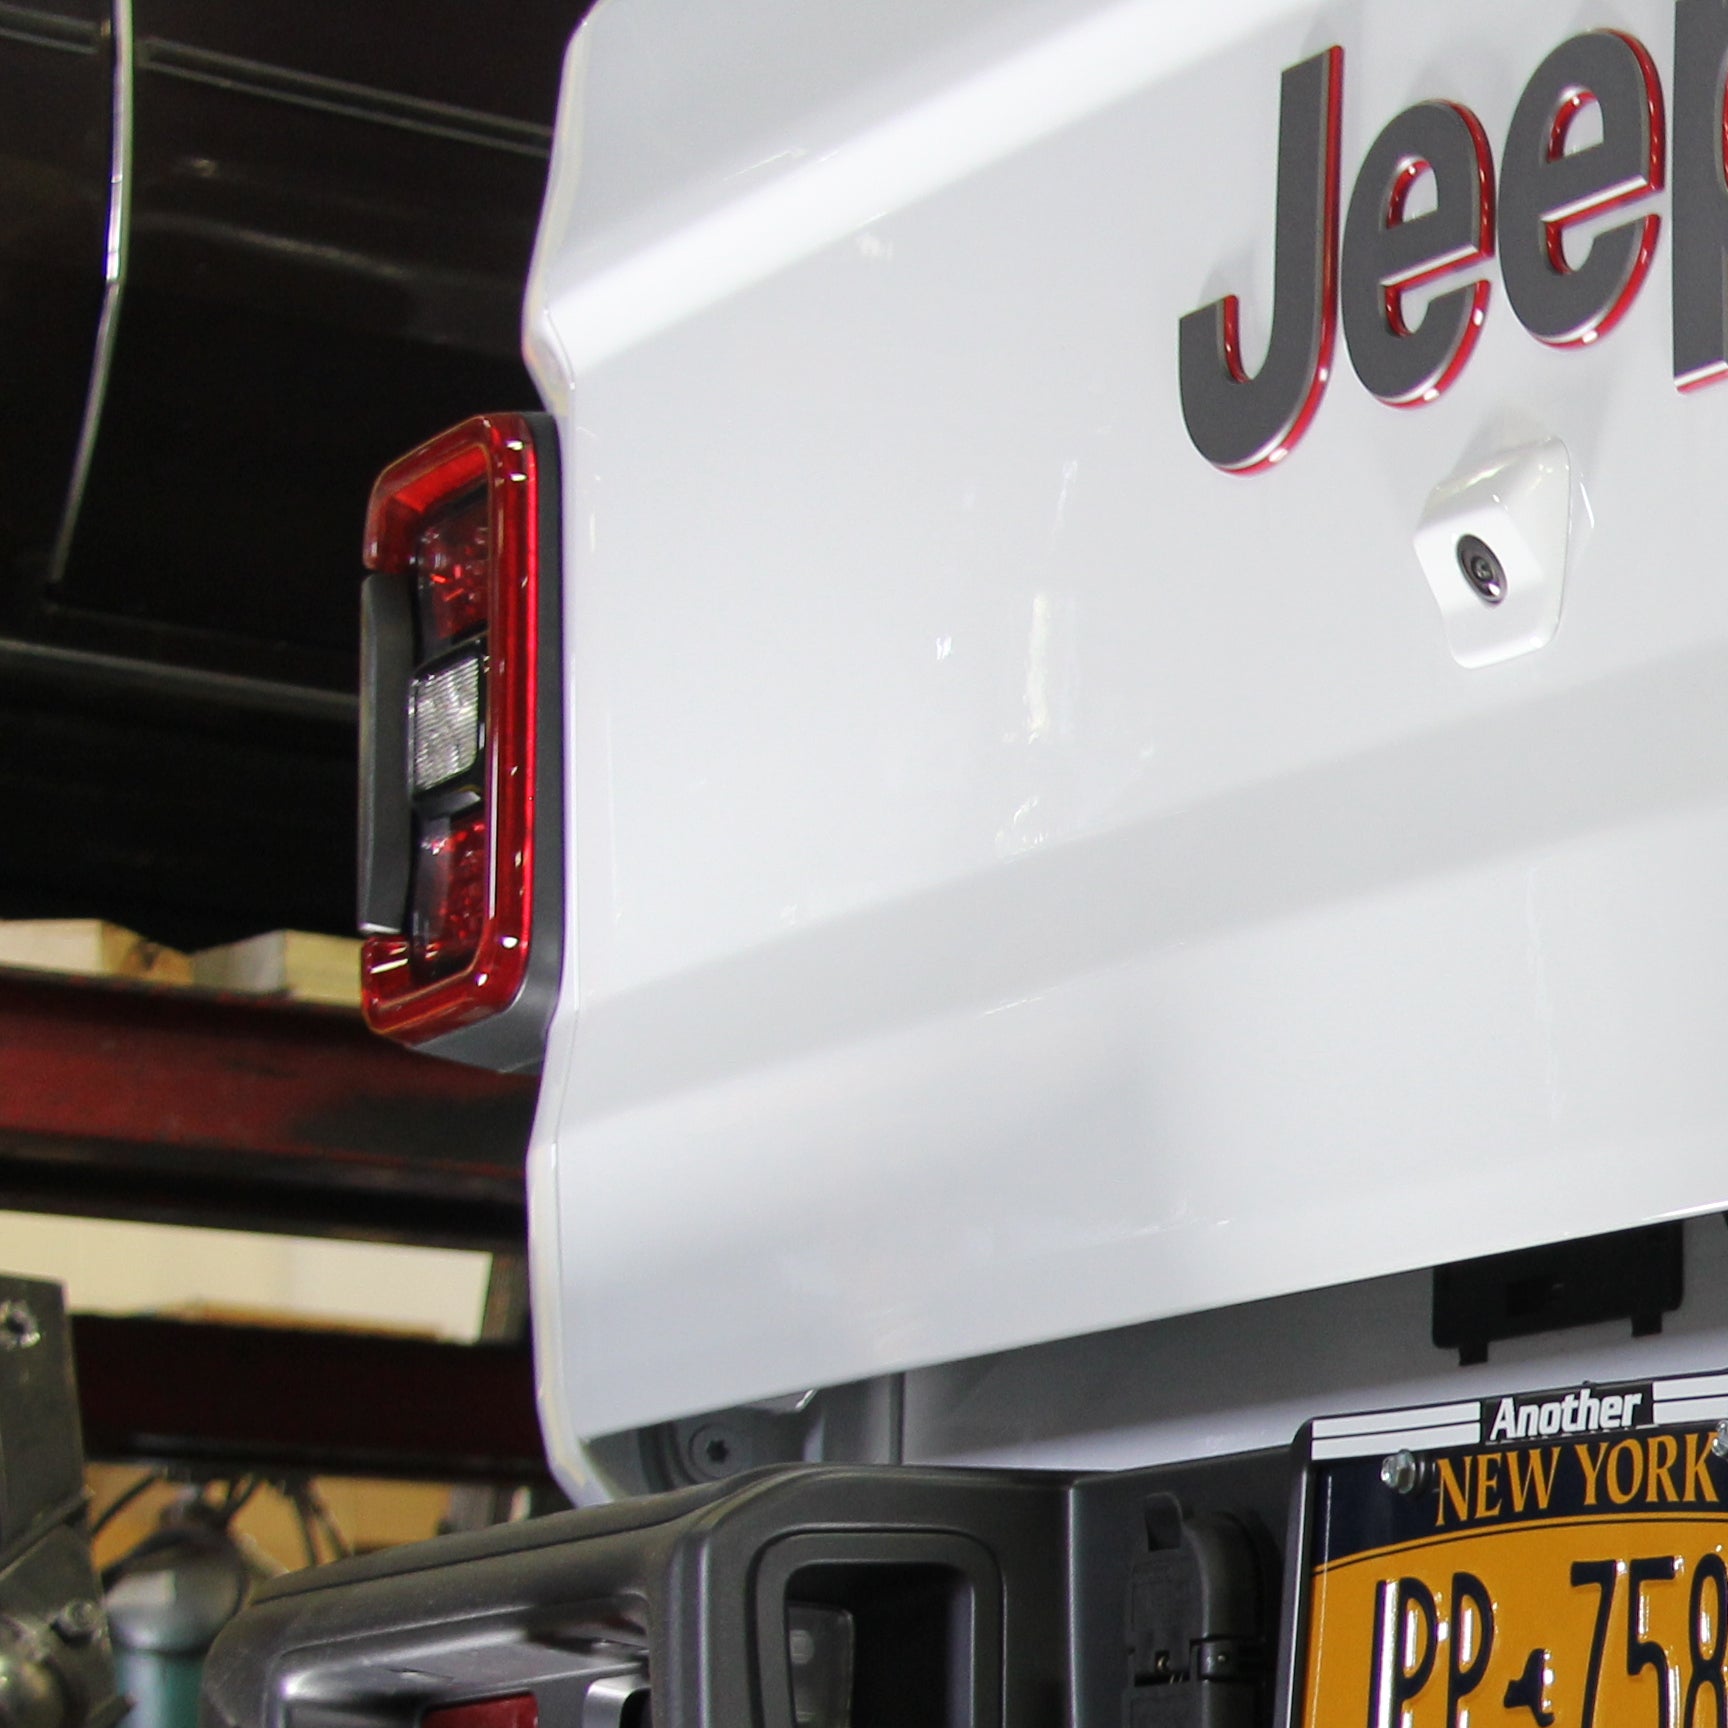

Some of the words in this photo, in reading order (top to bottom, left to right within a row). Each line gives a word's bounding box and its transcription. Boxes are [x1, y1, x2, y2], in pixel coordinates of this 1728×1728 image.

[1489, 1387, 1642, 1441] Another
[1435, 1445, 1561, 1527] NEW
[1574, 1430, 1720, 1506] YORK
